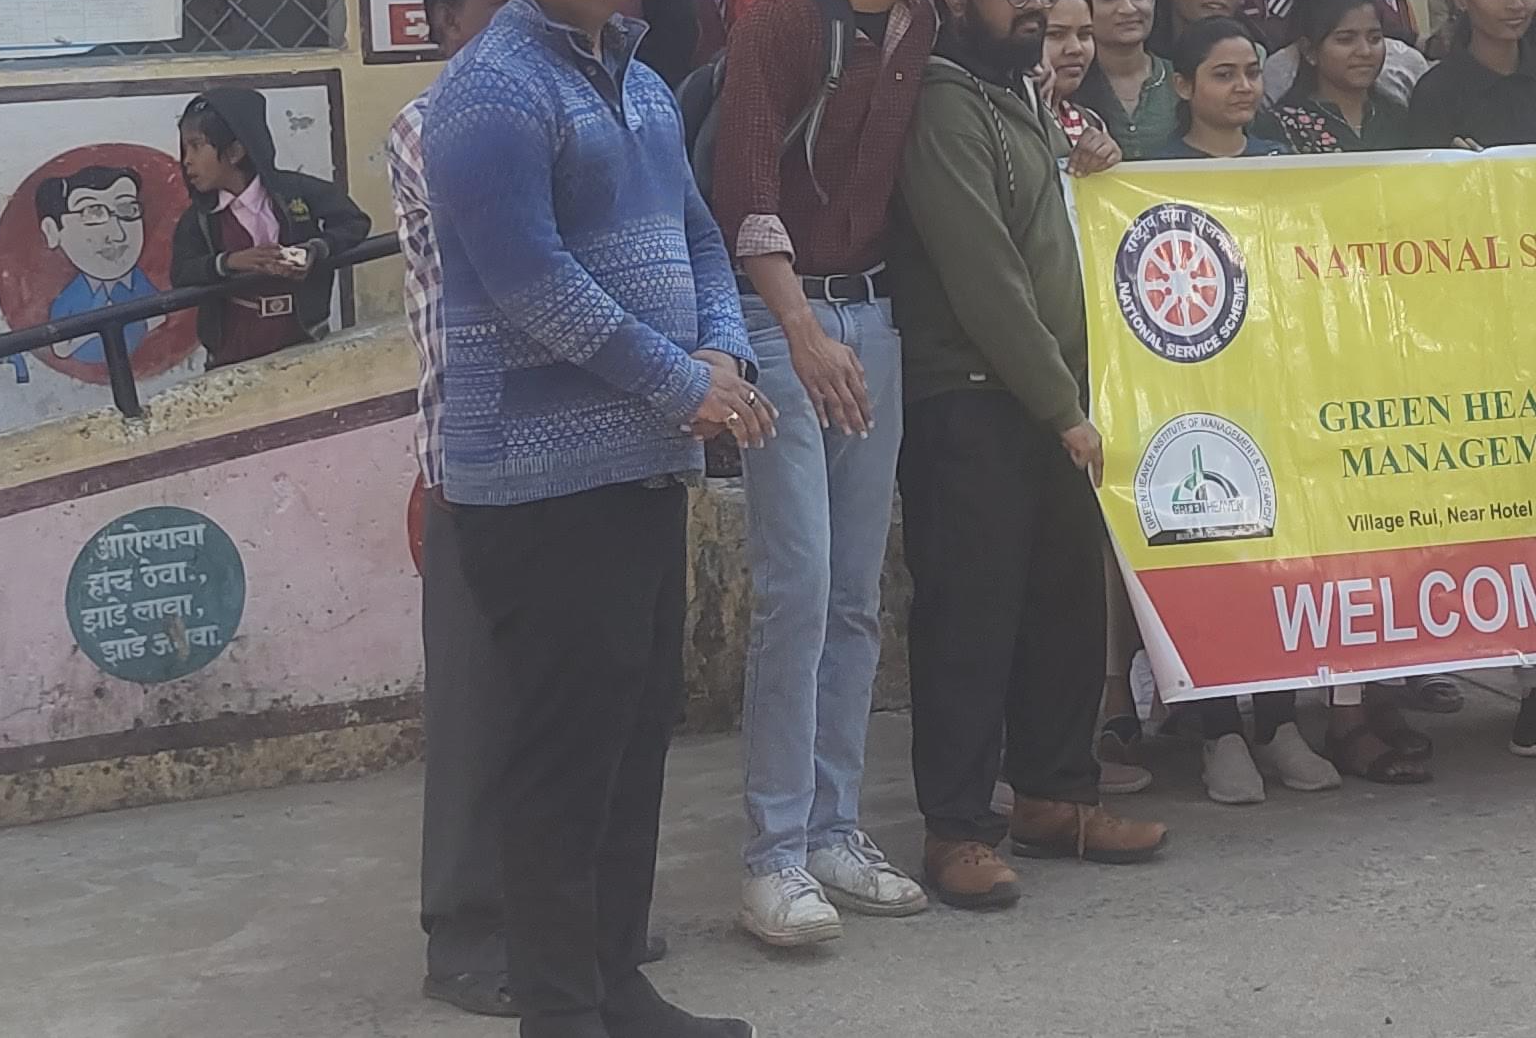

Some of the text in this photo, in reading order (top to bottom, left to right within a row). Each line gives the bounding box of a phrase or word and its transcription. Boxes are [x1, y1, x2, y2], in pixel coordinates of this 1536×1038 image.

[1295, 232, 1512, 280] NATIONAL
[1118, 277, 1246, 359] NATIONAL SERVICE SCHEME
[1319, 394, 1451, 434] GREEN
[1347, 509, 1405, 533] Village
[1409, 505, 1444, 528] Rui,
[1447, 503, 1485, 524] Near
[1489, 498, 1534, 520] Hotel
